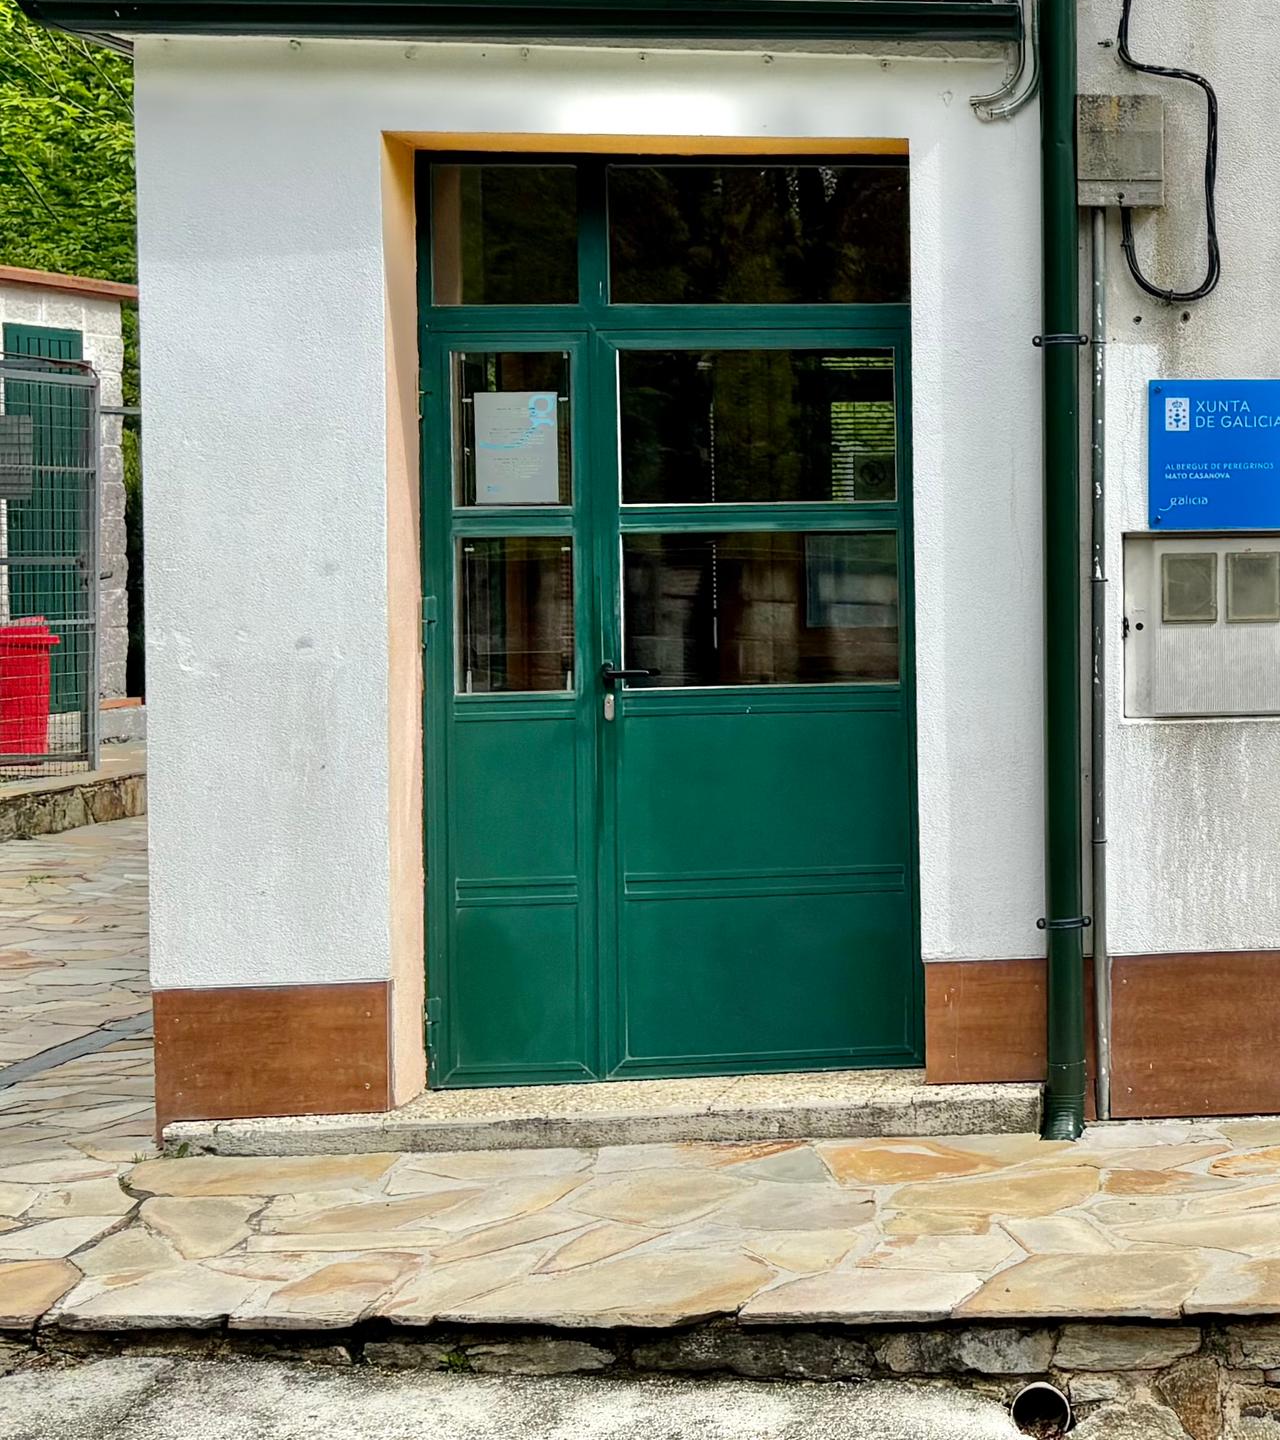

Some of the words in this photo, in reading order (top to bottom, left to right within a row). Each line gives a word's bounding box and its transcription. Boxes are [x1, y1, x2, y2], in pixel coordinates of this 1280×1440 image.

[1195, 400, 1251, 413] XUNTA
[1195, 415, 1215, 428] DE
[1165, 463, 1209, 471] ALBERGUE
[1210, 462, 1221, 470] DE
[1223, 462, 1274, 470] PEREGRINOS
[1189, 472, 1231, 480] CASANOVA
[1160, 496, 1208, 511] galicia
